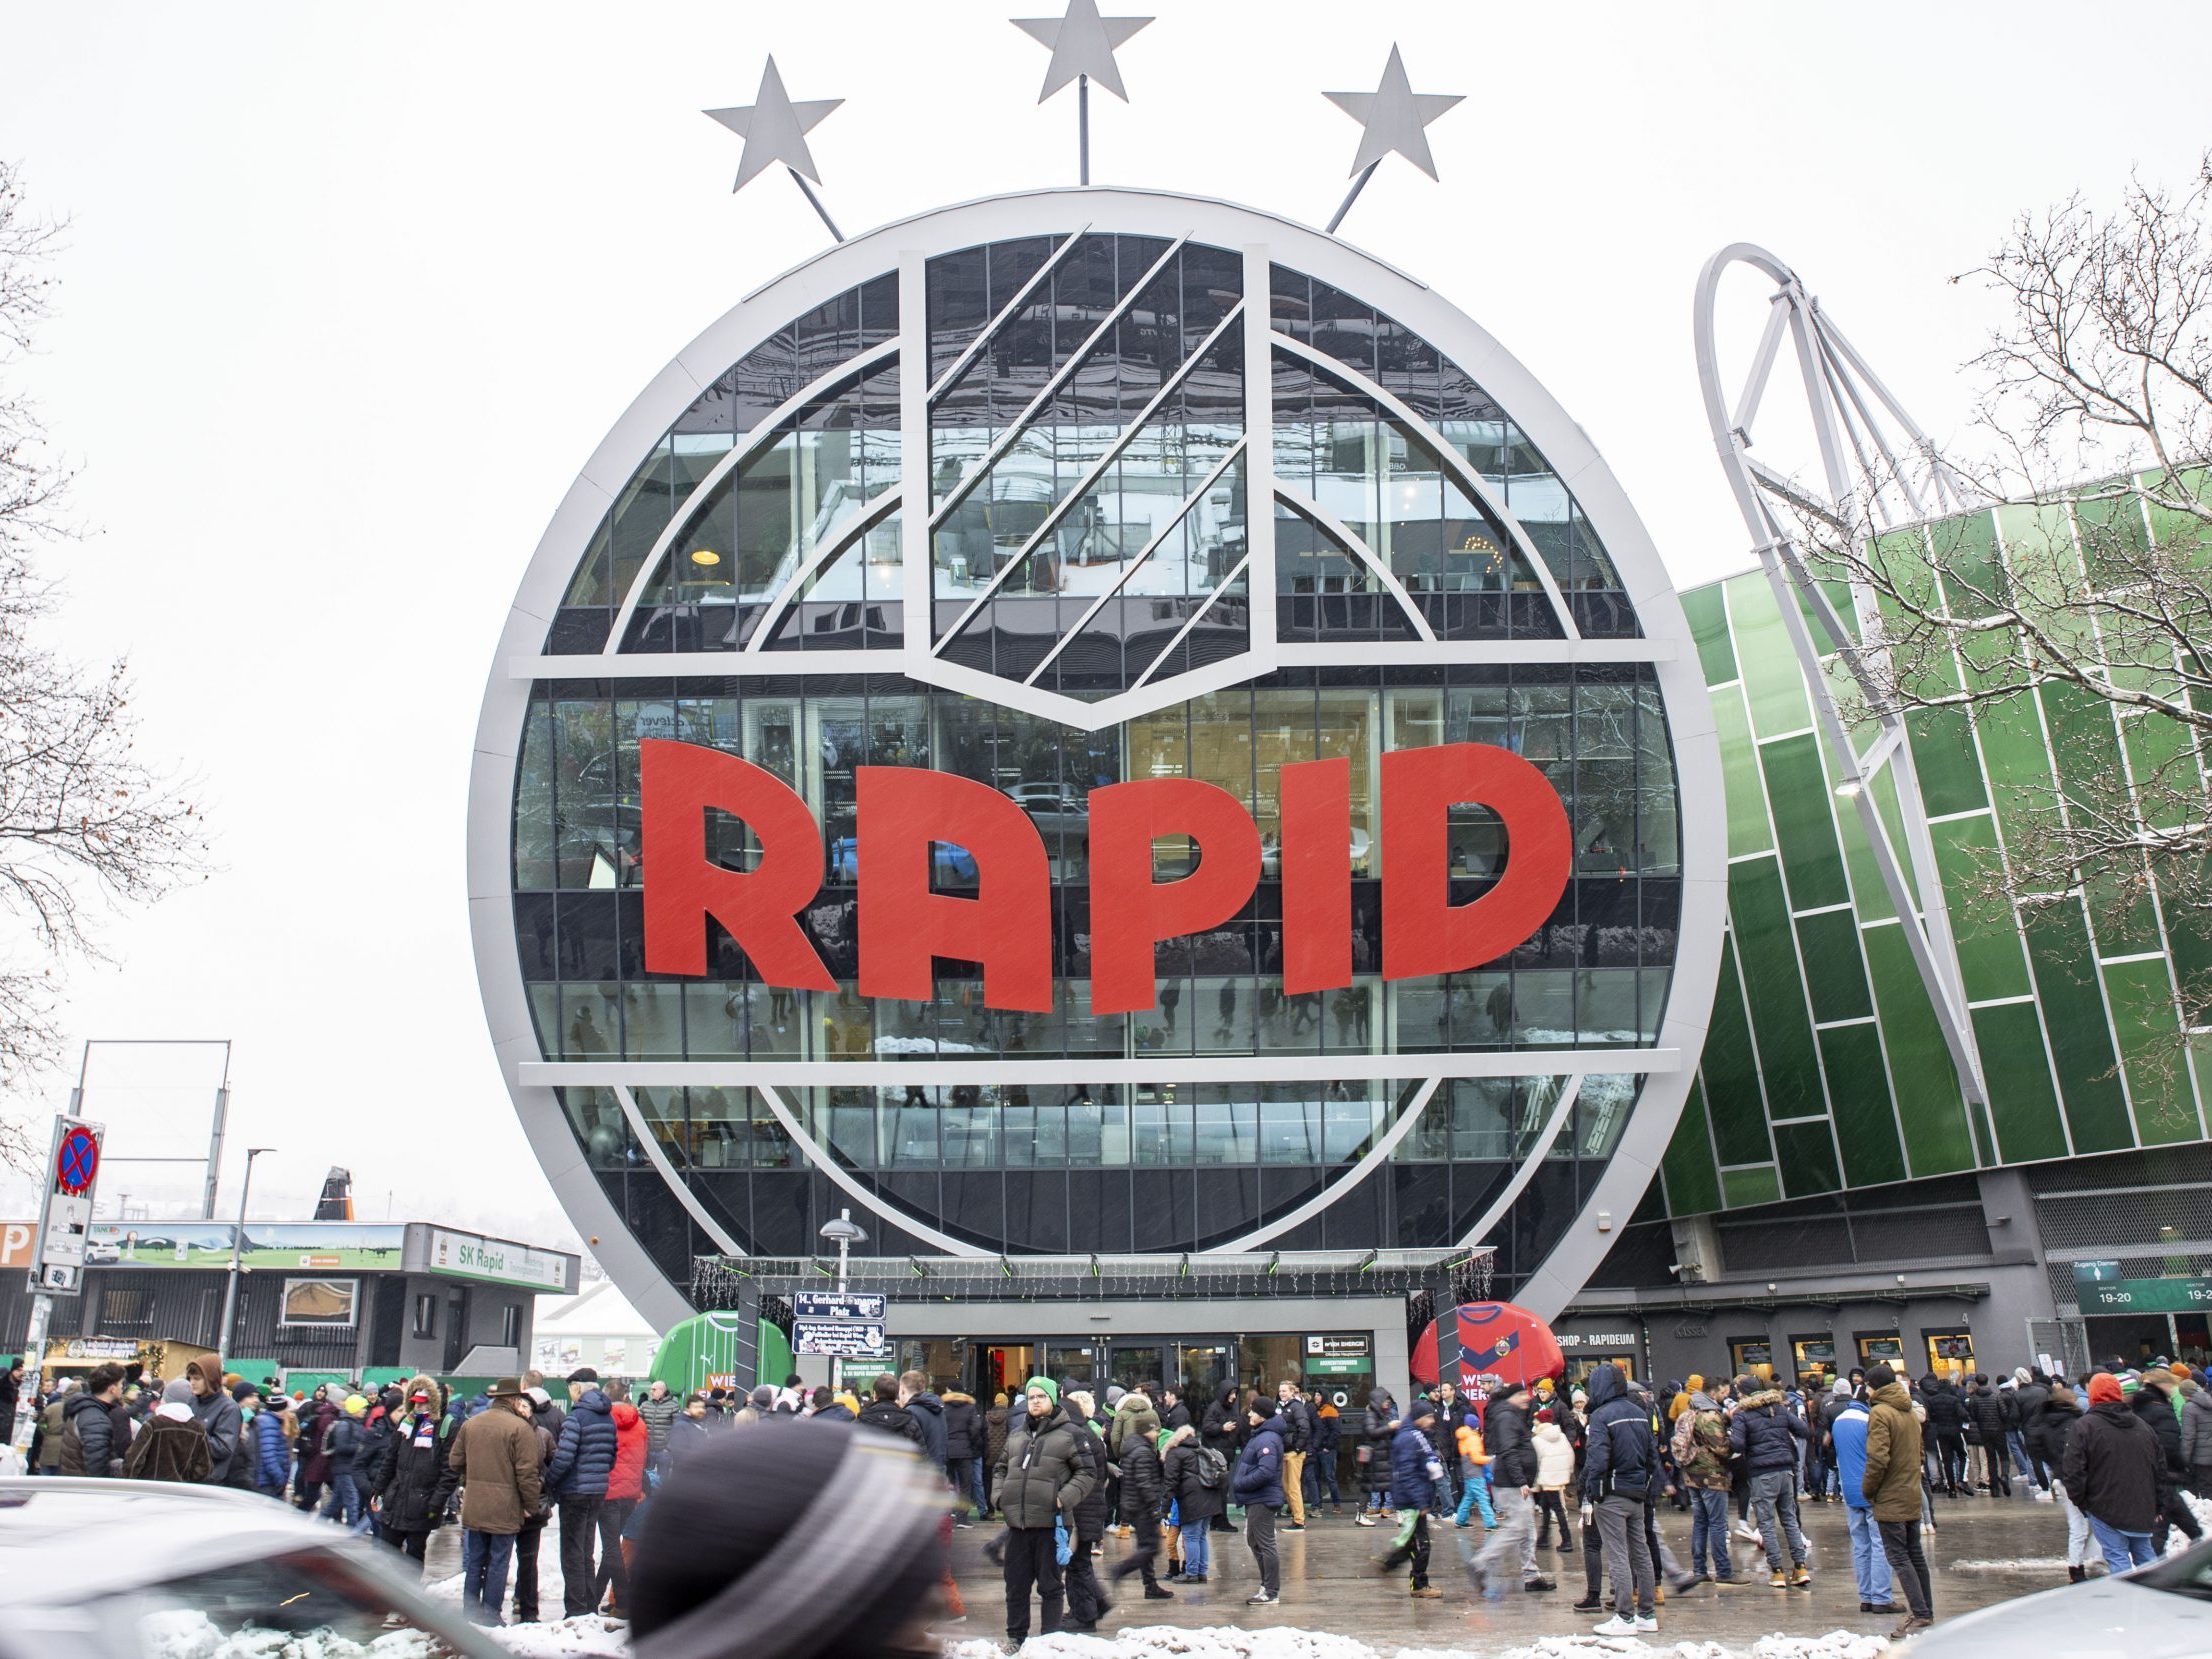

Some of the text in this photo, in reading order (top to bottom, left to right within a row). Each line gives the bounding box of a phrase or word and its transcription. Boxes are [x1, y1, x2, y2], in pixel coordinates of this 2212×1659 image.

[640, 737, 1573, 1015] RAPID
[459, 1244, 475, 1265] SK
[476, 1247, 504, 1273] Rapid
[2074, 1261, 2096, 1269] Zugang
[2099, 1292, 2132, 1303] 19-20
[2187, 1289, 2212, 1300] 19-2
[830, 1305, 850, 1316] Platz
[1891, 1316, 1899, 1328] 3
[1961, 1312, 1969, 1325] 4
[1826, 1320, 1833, 1331] 2
[1589, 1334, 1635, 1346] RAPIDEUM
